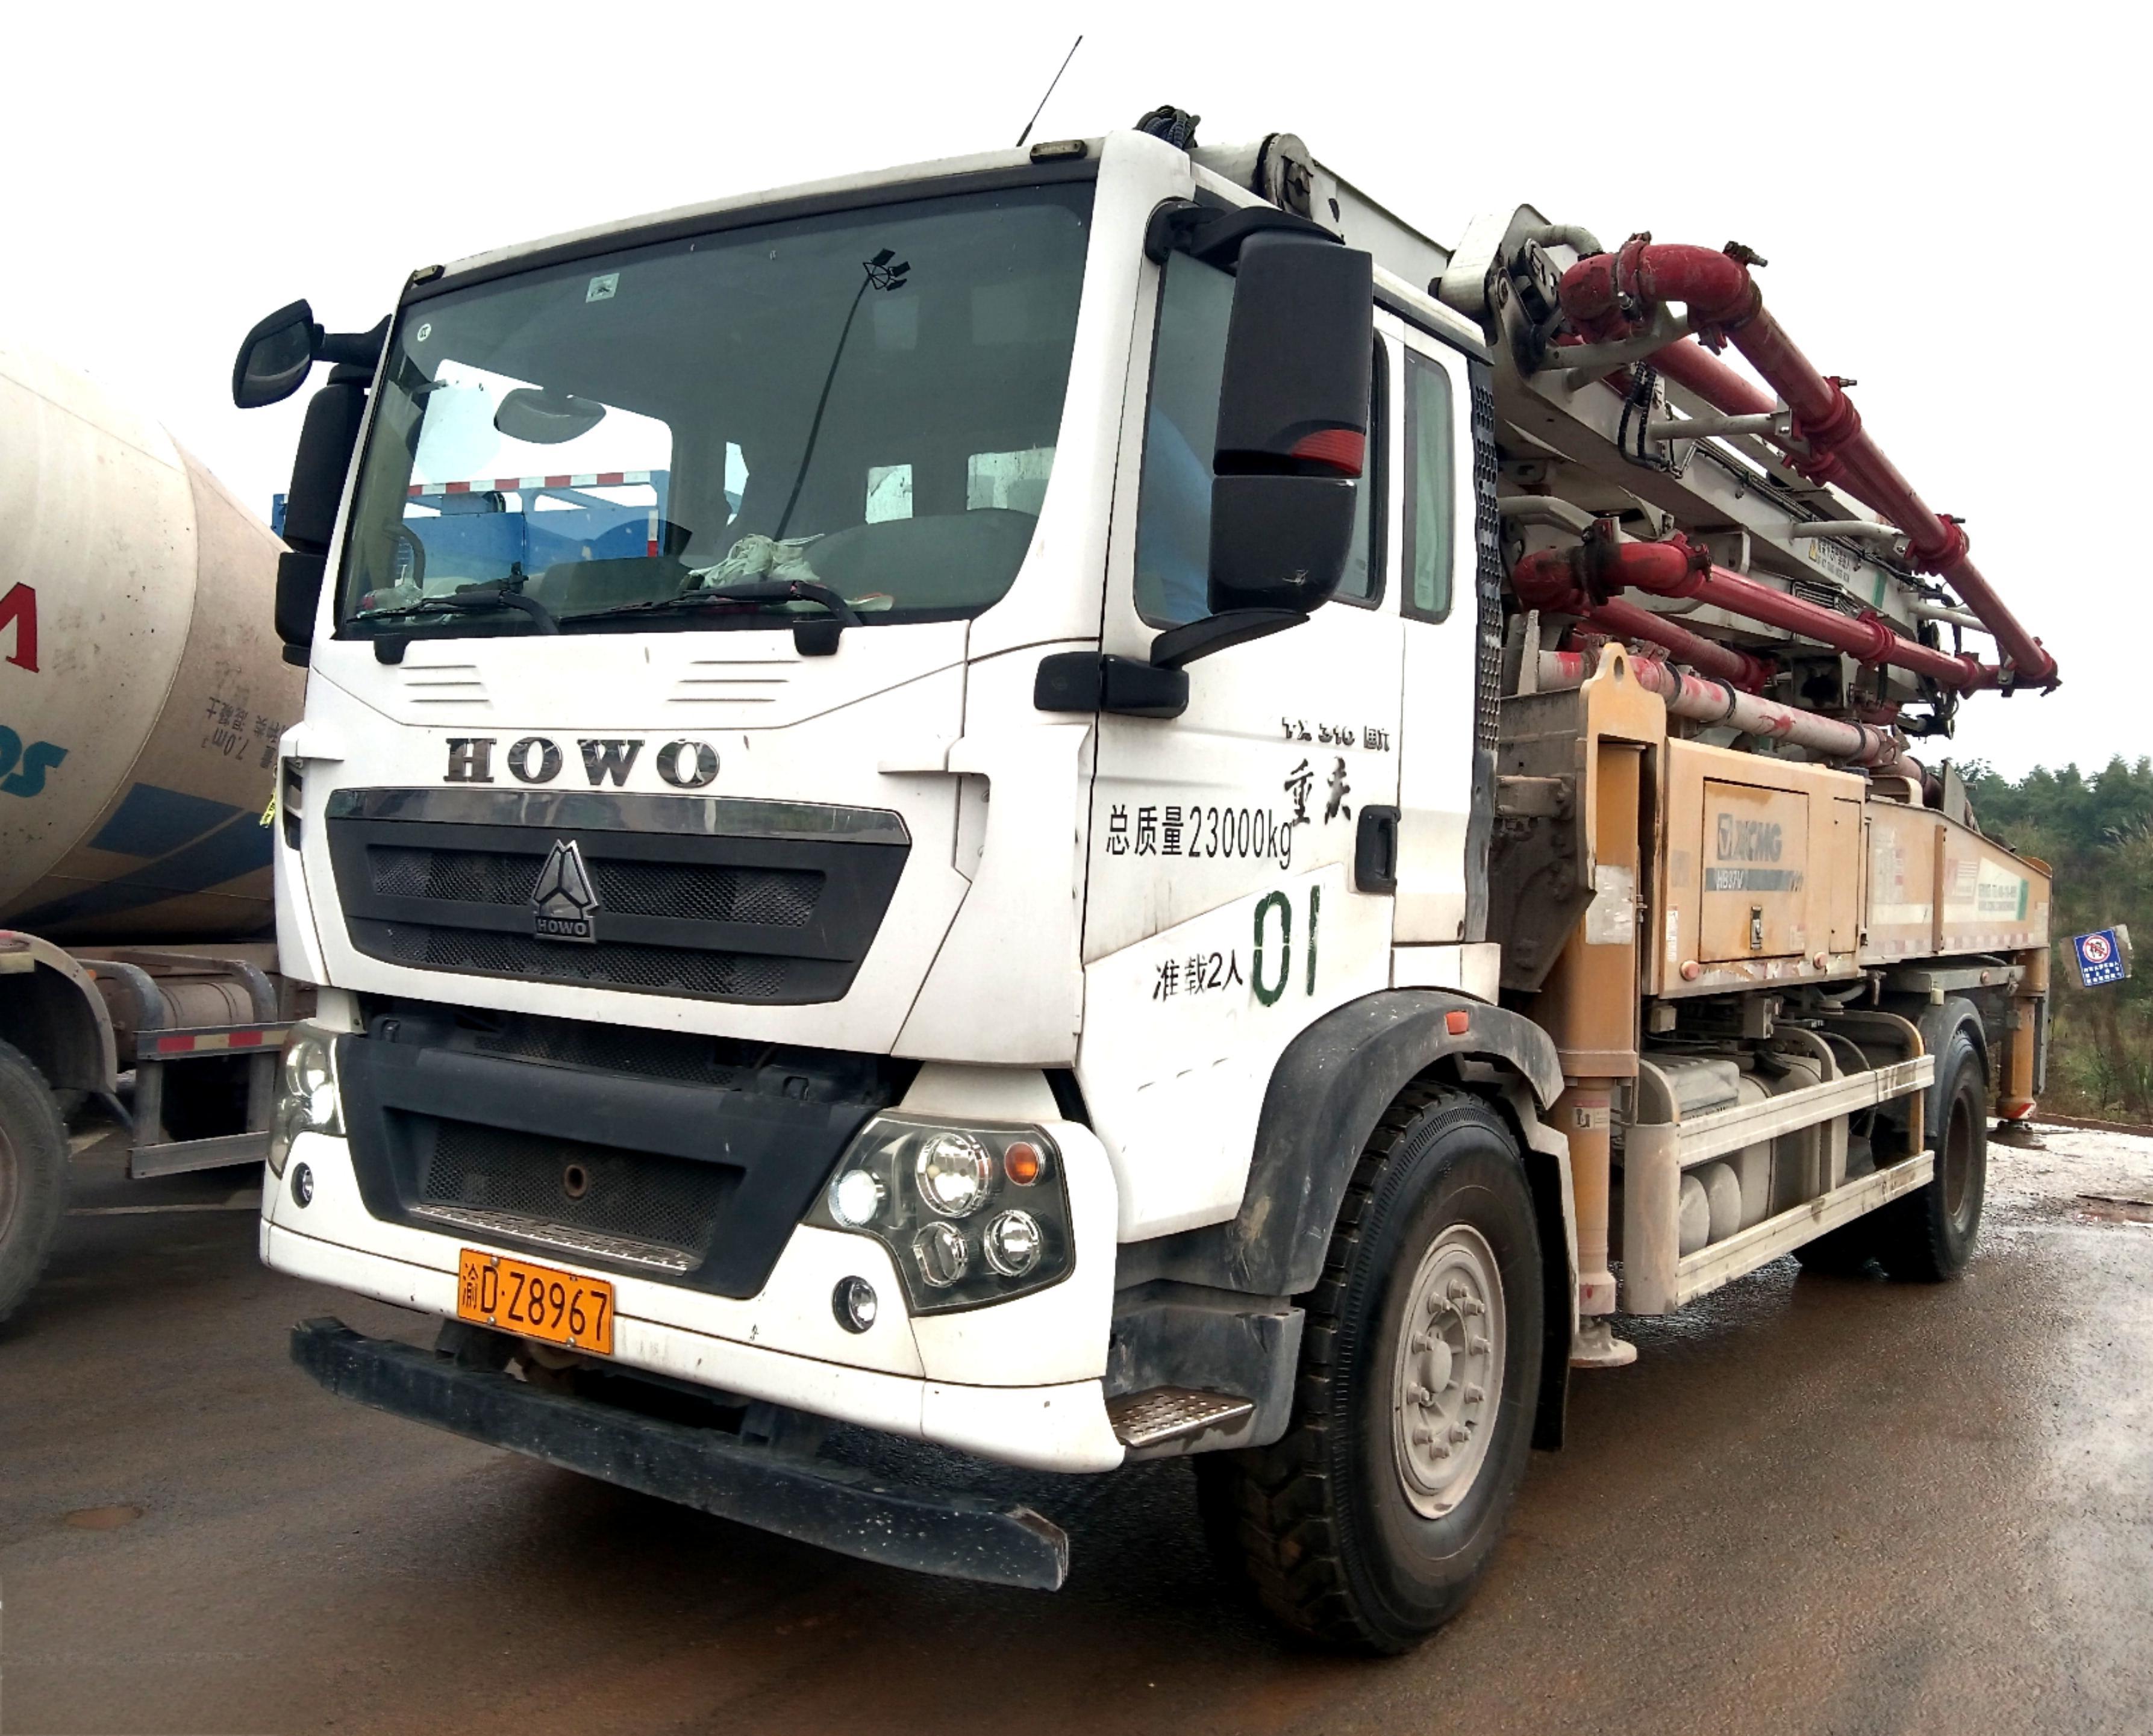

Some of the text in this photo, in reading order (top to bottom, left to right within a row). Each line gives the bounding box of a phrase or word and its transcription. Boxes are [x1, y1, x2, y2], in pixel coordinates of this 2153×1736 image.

[443, 737, 720, 789] HOWO
[1106, 804, 1292, 870] 总质量23000kg
[537, 919, 587, 935] HOWO
[1252, 884, 1320, 1008] 01
[1152, 949, 1243, 1002] 准载2人
